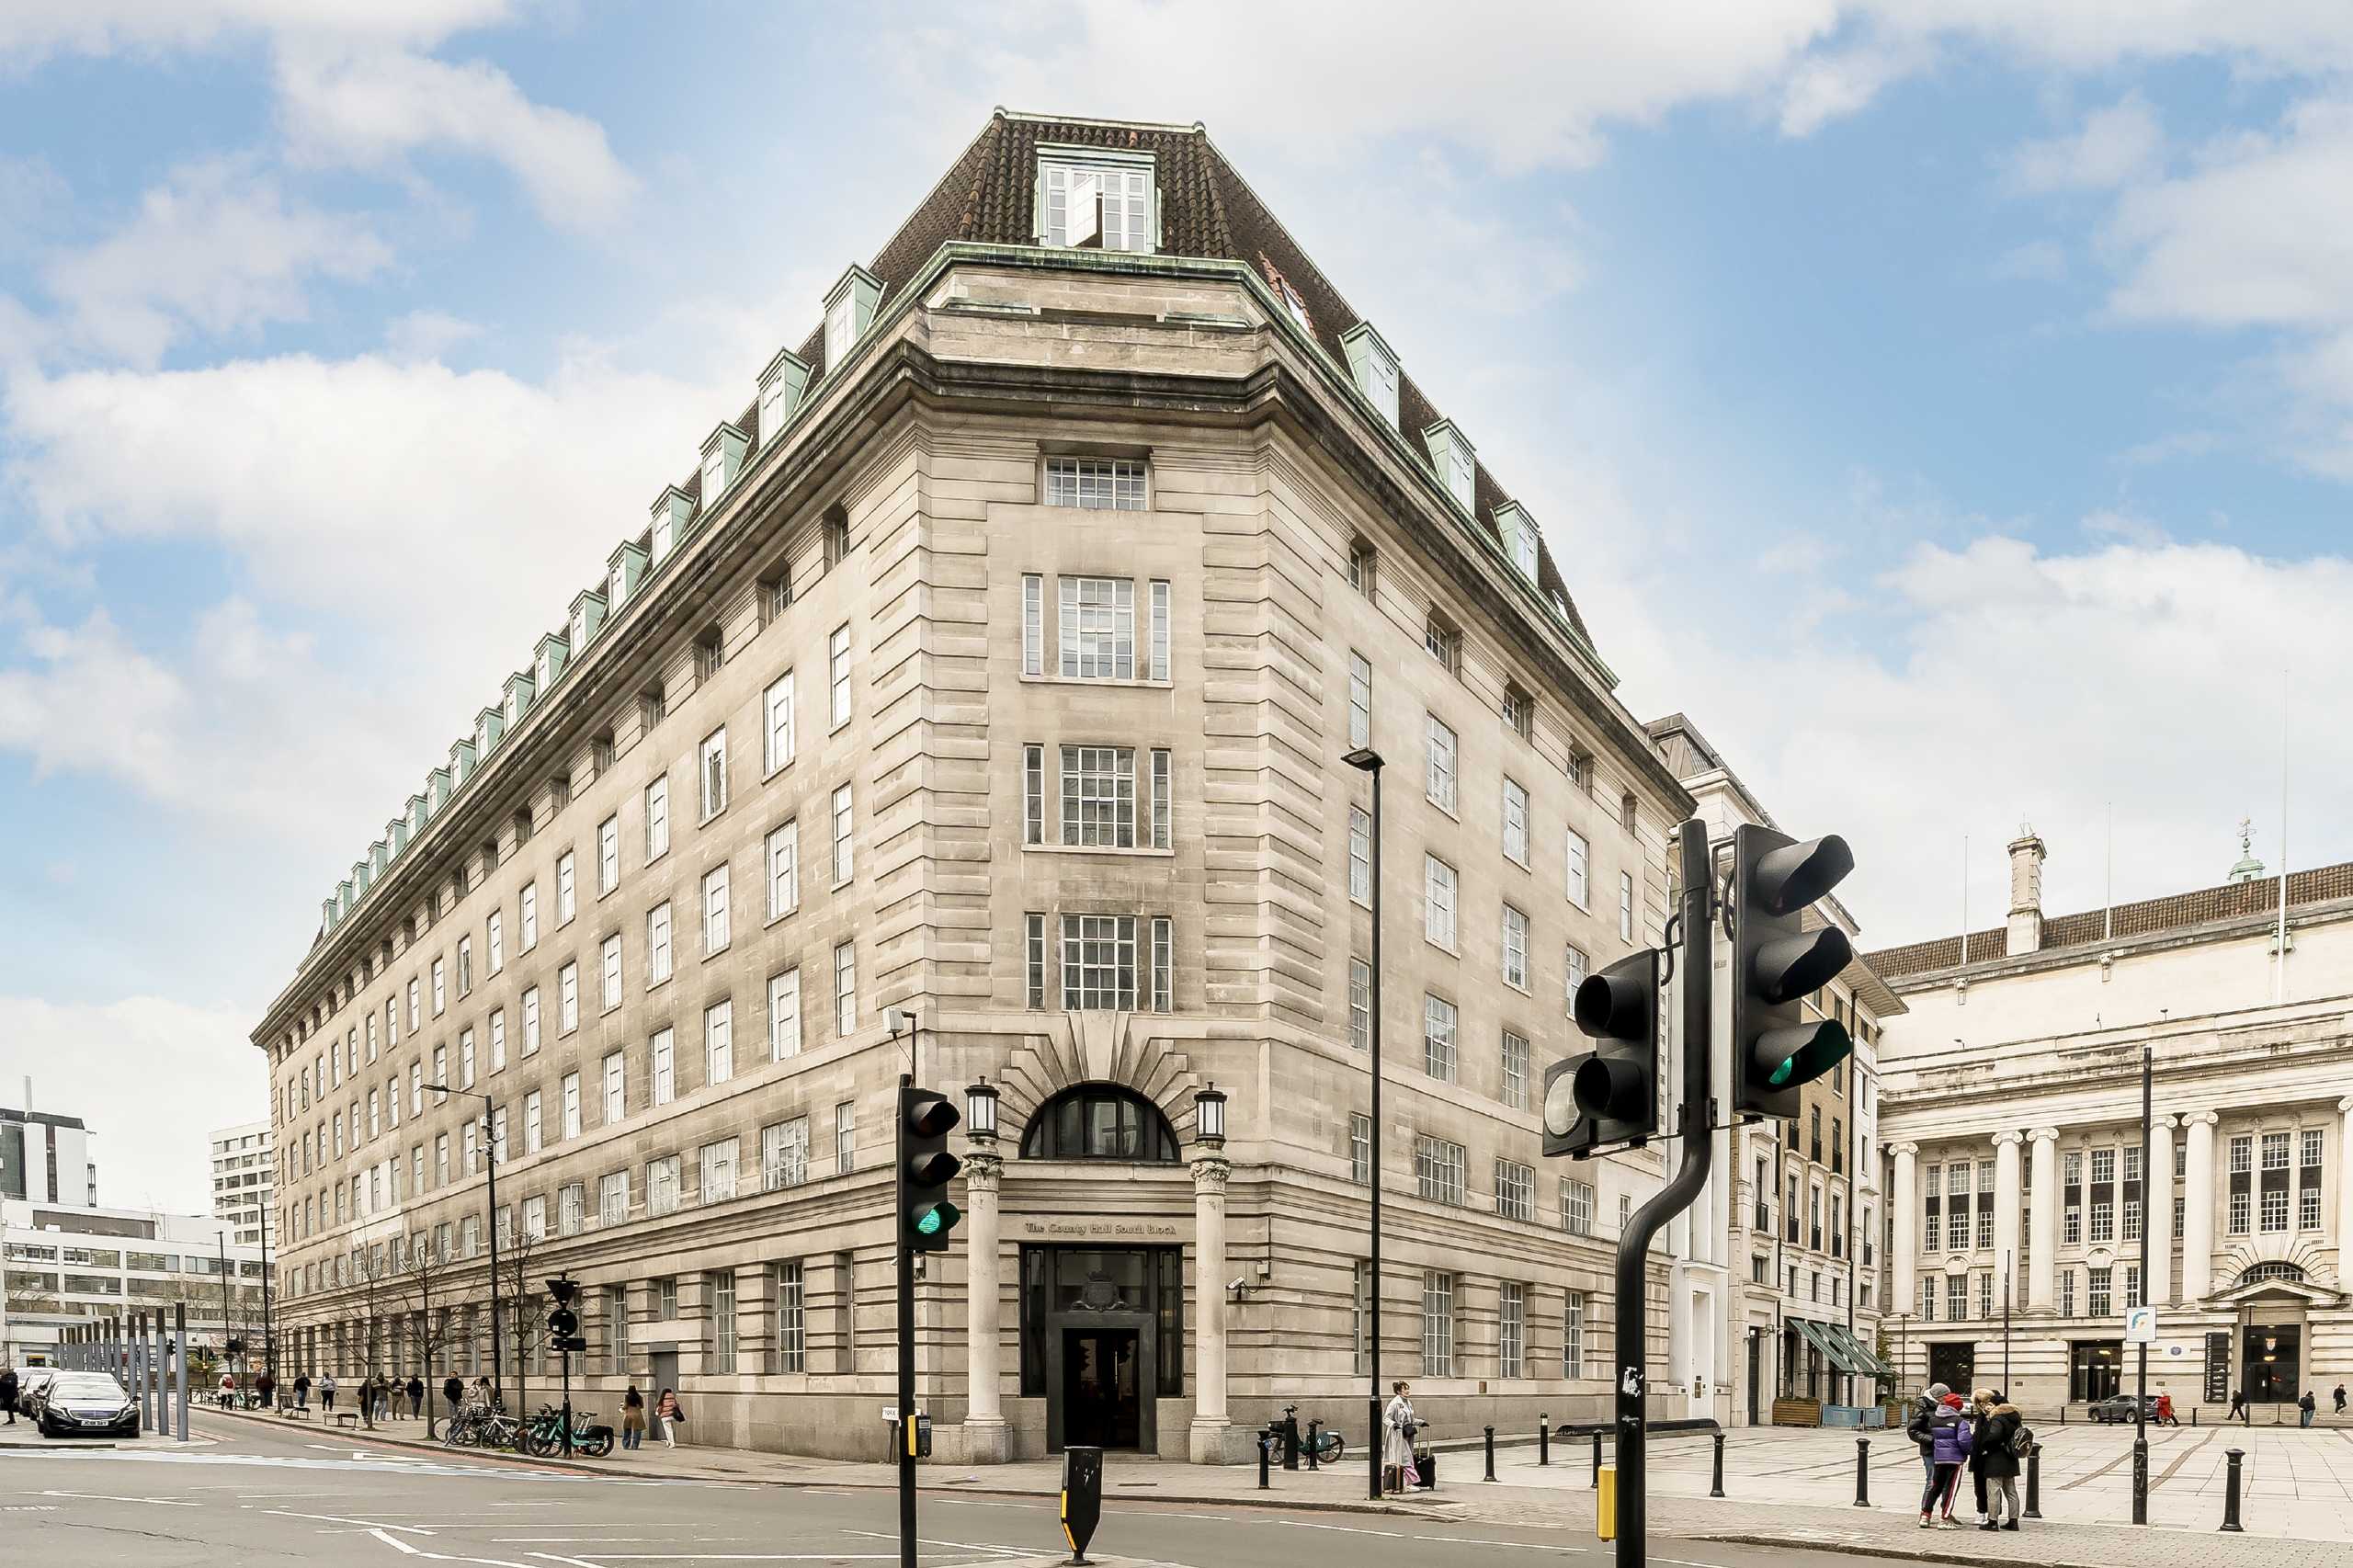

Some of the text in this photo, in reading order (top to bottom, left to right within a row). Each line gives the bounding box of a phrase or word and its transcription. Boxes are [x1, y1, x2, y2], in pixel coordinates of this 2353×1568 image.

[1025, 1222, 1044, 1233] The
[1049, 1223, 1086, 1236] County
[1090, 1223, 1111, 1234] Hall
[1115, 1223, 1144, 1234] South
